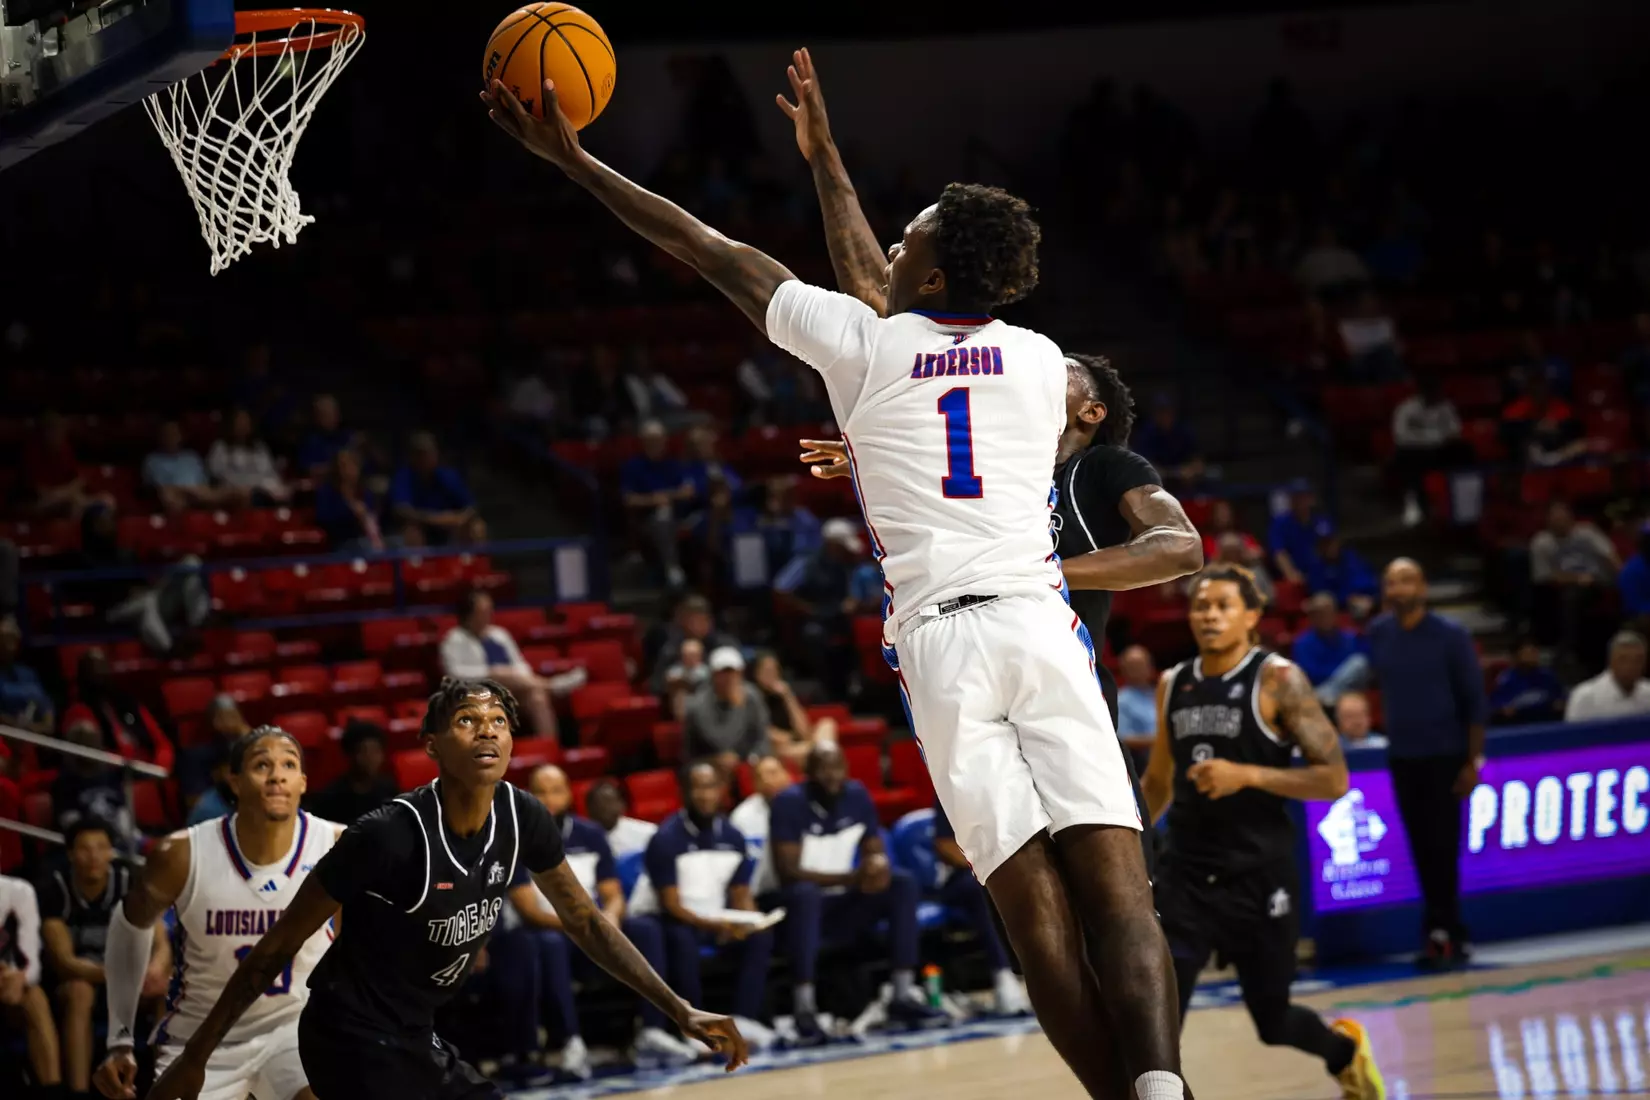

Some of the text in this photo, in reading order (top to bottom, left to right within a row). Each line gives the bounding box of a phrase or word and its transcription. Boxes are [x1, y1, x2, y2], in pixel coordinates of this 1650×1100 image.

[911, 346, 1004, 379] ANDERSON
[937, 387, 983, 498] 1
[1468, 765, 1650, 854] PROTEC
[205, 909, 287, 936] LOUISIAN
[428, 897, 503, 946] TIGERS
[430, 953, 470, 986] 4
